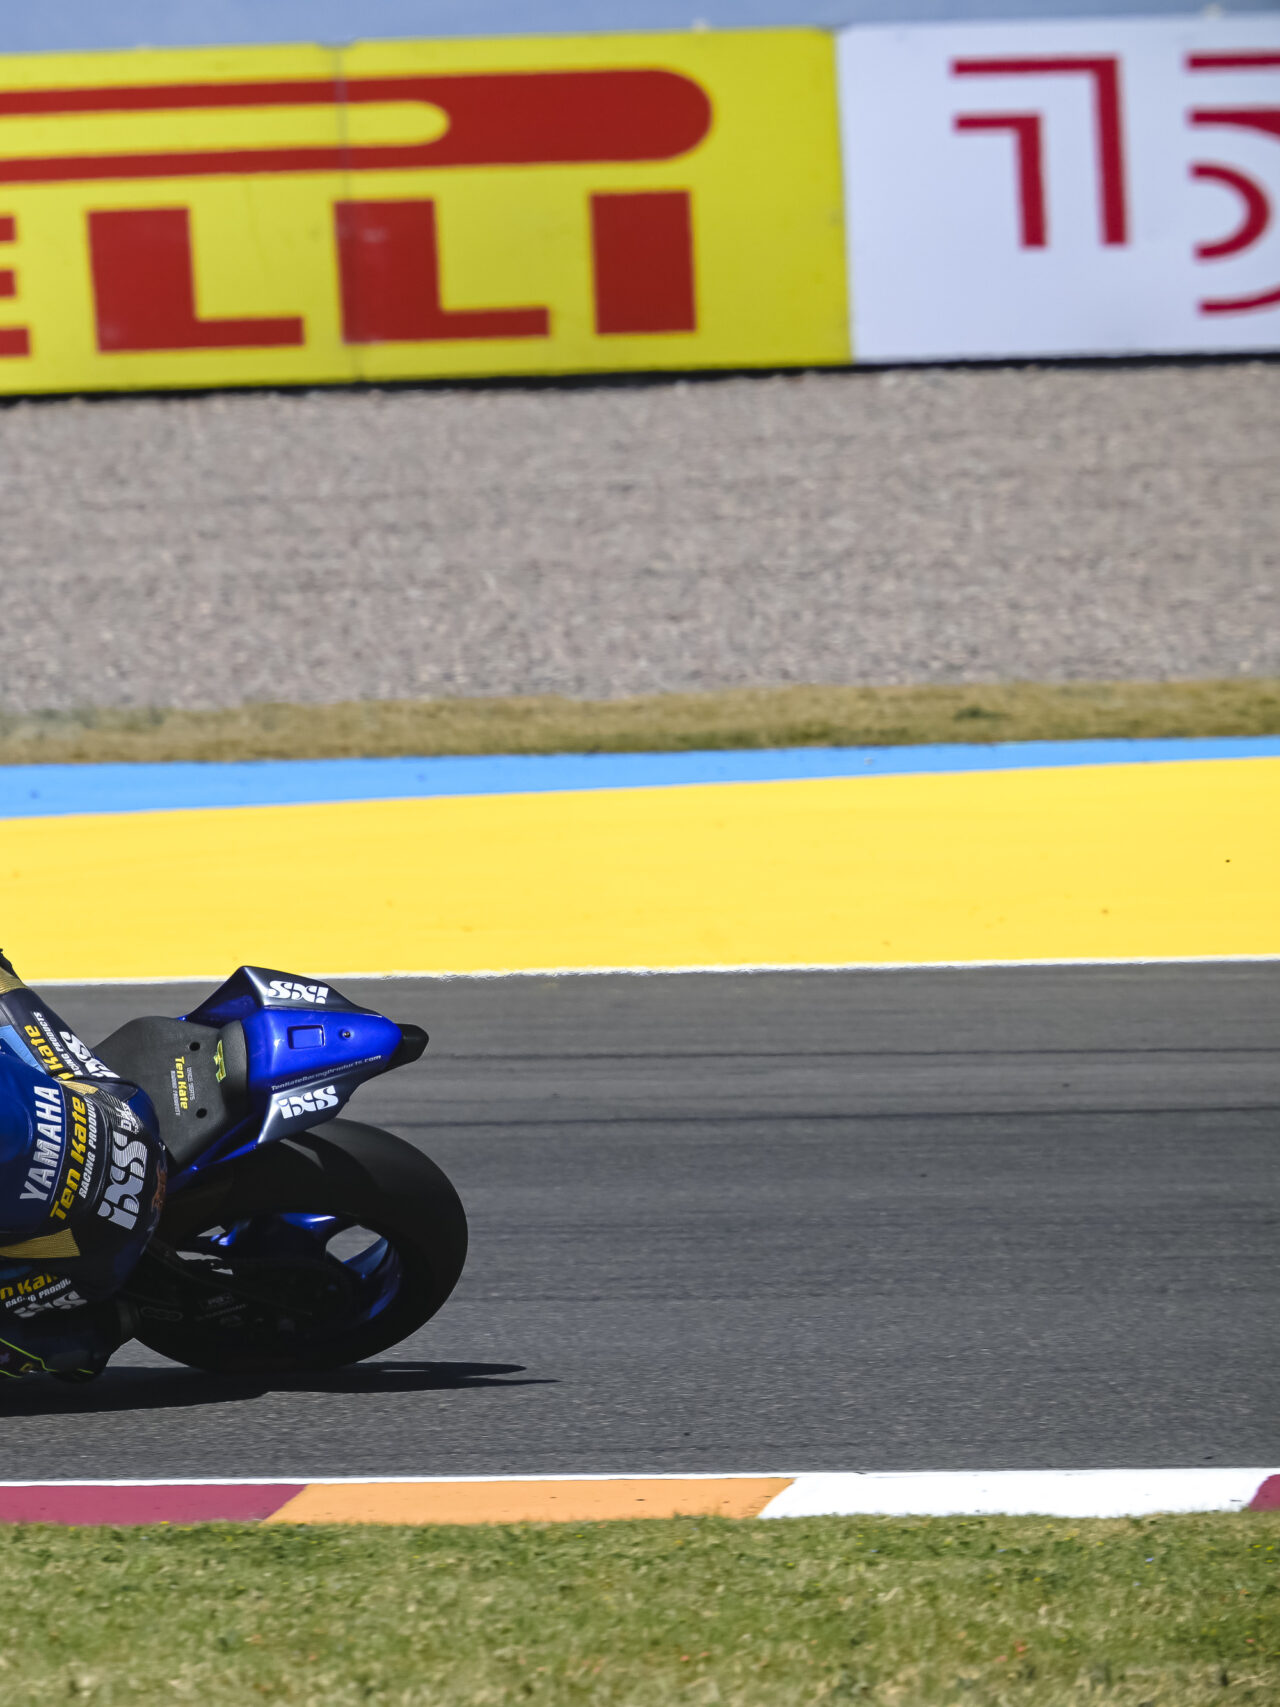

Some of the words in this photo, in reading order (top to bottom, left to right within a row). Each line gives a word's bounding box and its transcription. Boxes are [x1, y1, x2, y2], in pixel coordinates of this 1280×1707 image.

[24, 1025, 64, 1071] Kate
[61, 1053, 84, 1076] ACING
[174, 1056, 185, 1079] Ten
[177, 1081, 189, 1109] Kate
[20, 1086, 62, 1201] YAMAHA
[50, 1168, 81, 1220] Ten
[70, 1096, 87, 1165] Kate
[78, 1151, 96, 1198] RACING
[17, 1273, 58, 1295] Kat
[5, 1294, 37, 1308] RACG
